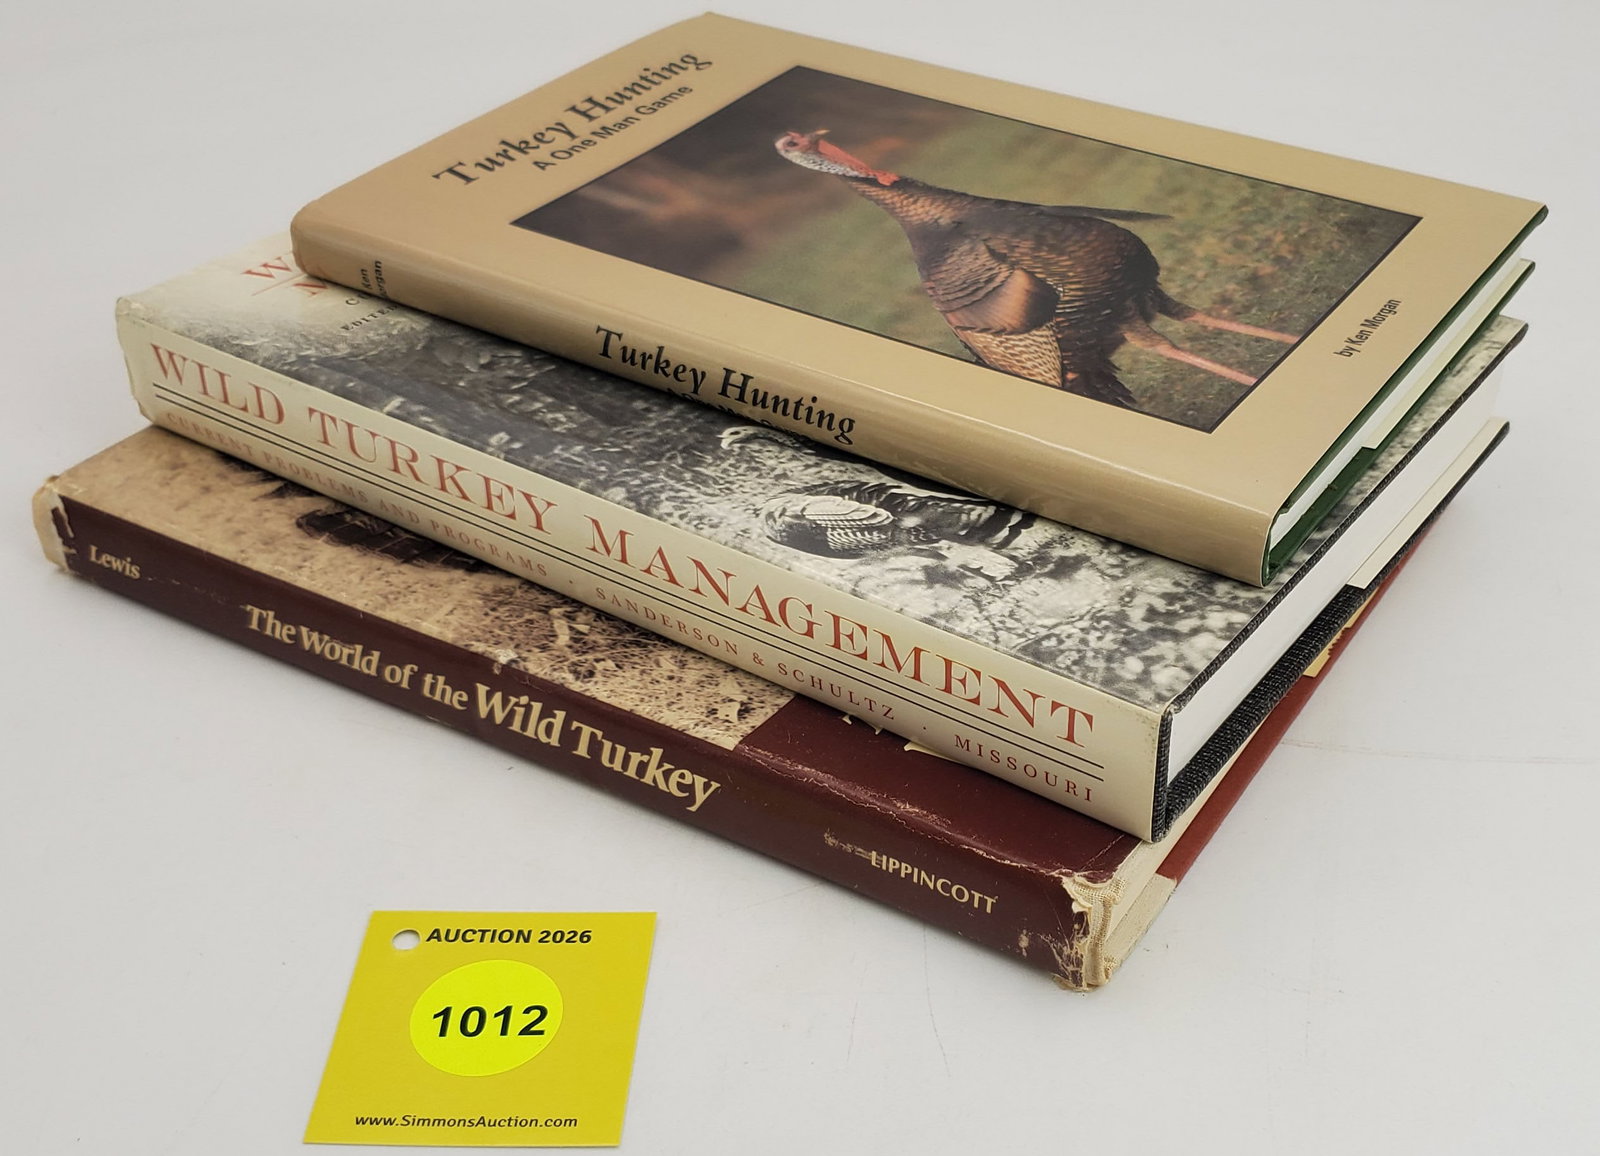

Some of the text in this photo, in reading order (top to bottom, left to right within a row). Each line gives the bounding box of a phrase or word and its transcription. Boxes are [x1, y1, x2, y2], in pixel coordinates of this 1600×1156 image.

[432, 52, 713, 185] Turkey Hunting
[532, 84, 693, 171] A One Man Game
[1333, 299, 1402, 357] by Ken Morgan
[596, 325, 856, 445] Turkey Hunting
[89, 545, 141, 580] Lewis
[150, 343, 1094, 748] WILD TURKEY MANAGEMENT
[166, 412, 1093, 802] CURRENT PROBLEMS AND PROGRAMS SANDERSON & SCHULTZ MISSOURI
[246, 604, 722, 813] The World of the Wild Turkey
[870, 850, 997, 914] LIPPINCOTT
[425, 927, 593, 945] AUCTION 2026
[432, 1004, 549, 1038] 1012
[354, 1114, 579, 1129] www.SimmonsAuction.com
